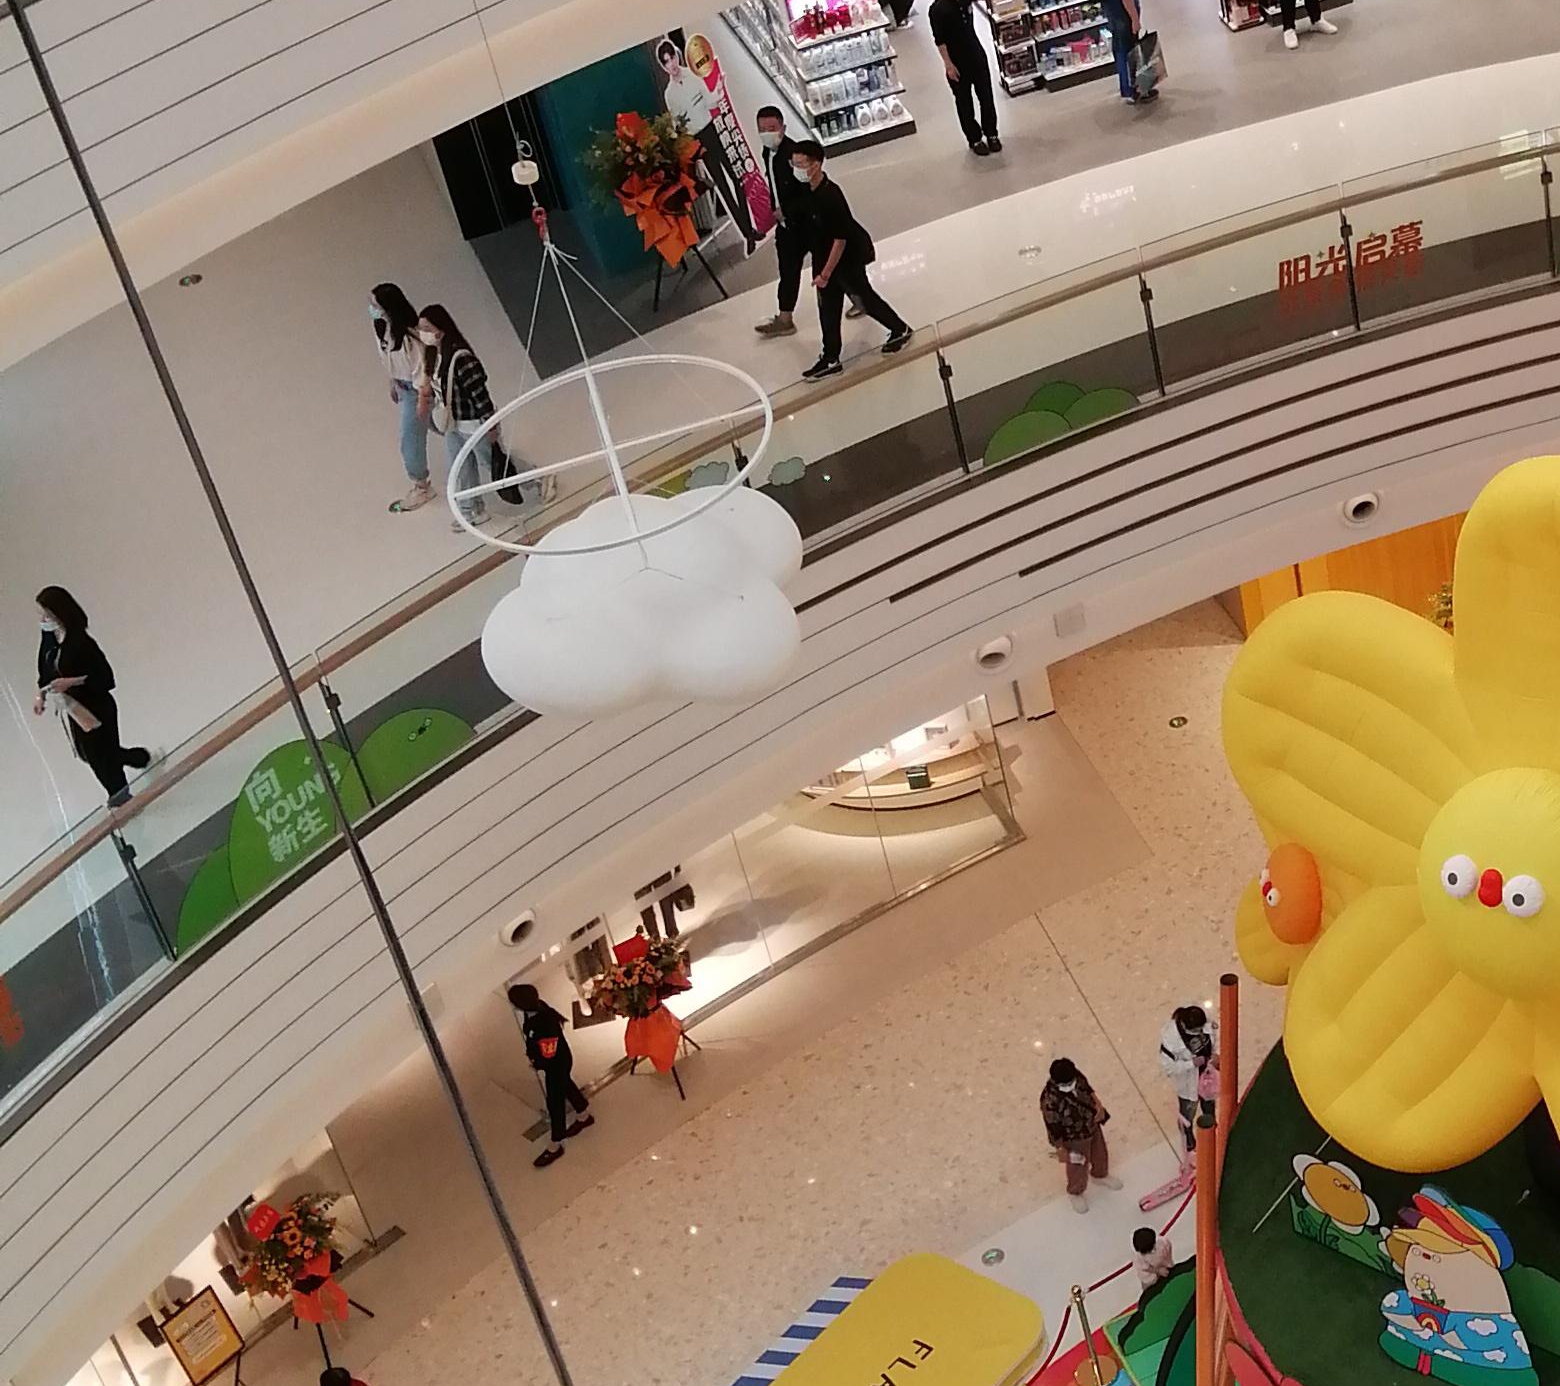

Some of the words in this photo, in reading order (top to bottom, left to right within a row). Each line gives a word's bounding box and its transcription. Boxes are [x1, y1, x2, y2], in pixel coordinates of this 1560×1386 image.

[1278, 220, 1425, 290] 阳光启幕
[244, 767, 282, 814] 向
[268, 807, 328, 862] 新生
